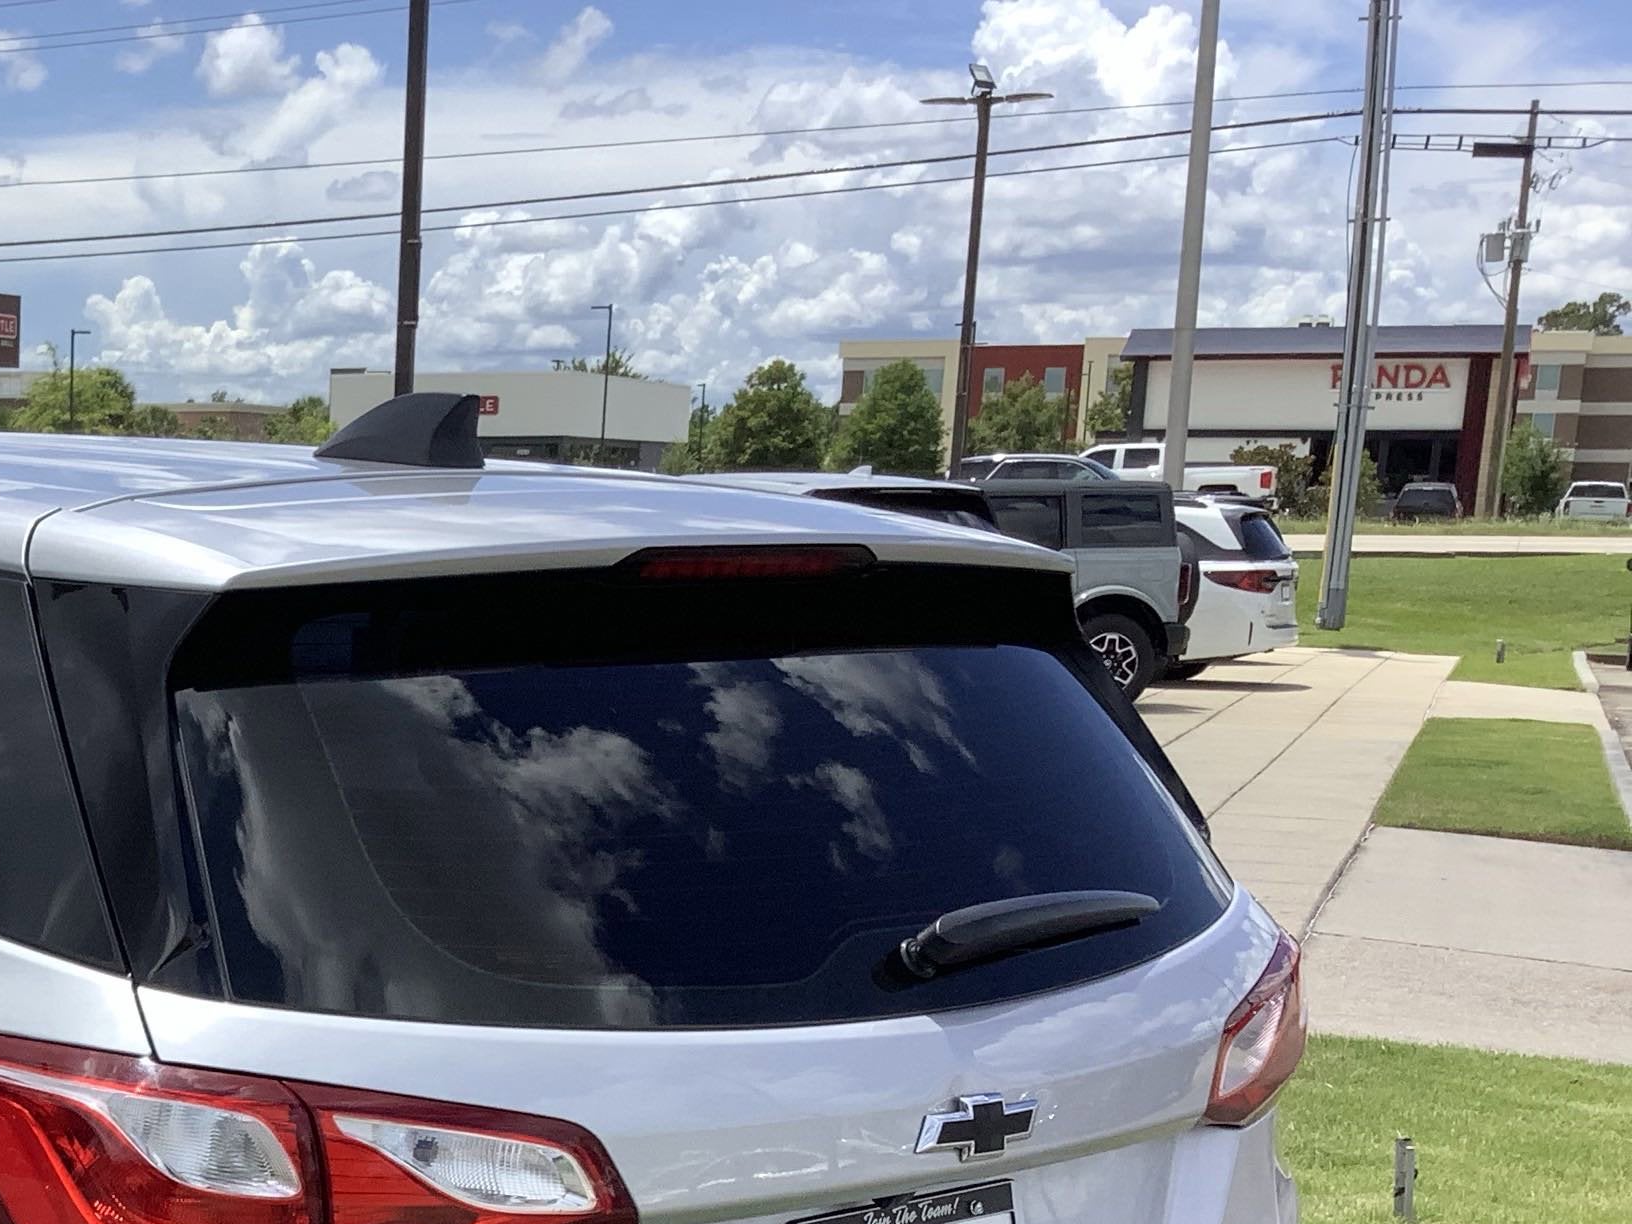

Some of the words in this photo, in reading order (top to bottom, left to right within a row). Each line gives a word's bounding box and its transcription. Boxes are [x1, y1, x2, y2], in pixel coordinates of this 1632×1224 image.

[1331, 363, 1451, 389] PNDA
[1375, 392, 1424, 401] PRESS
[917, 1197, 960, 1221] Team!
